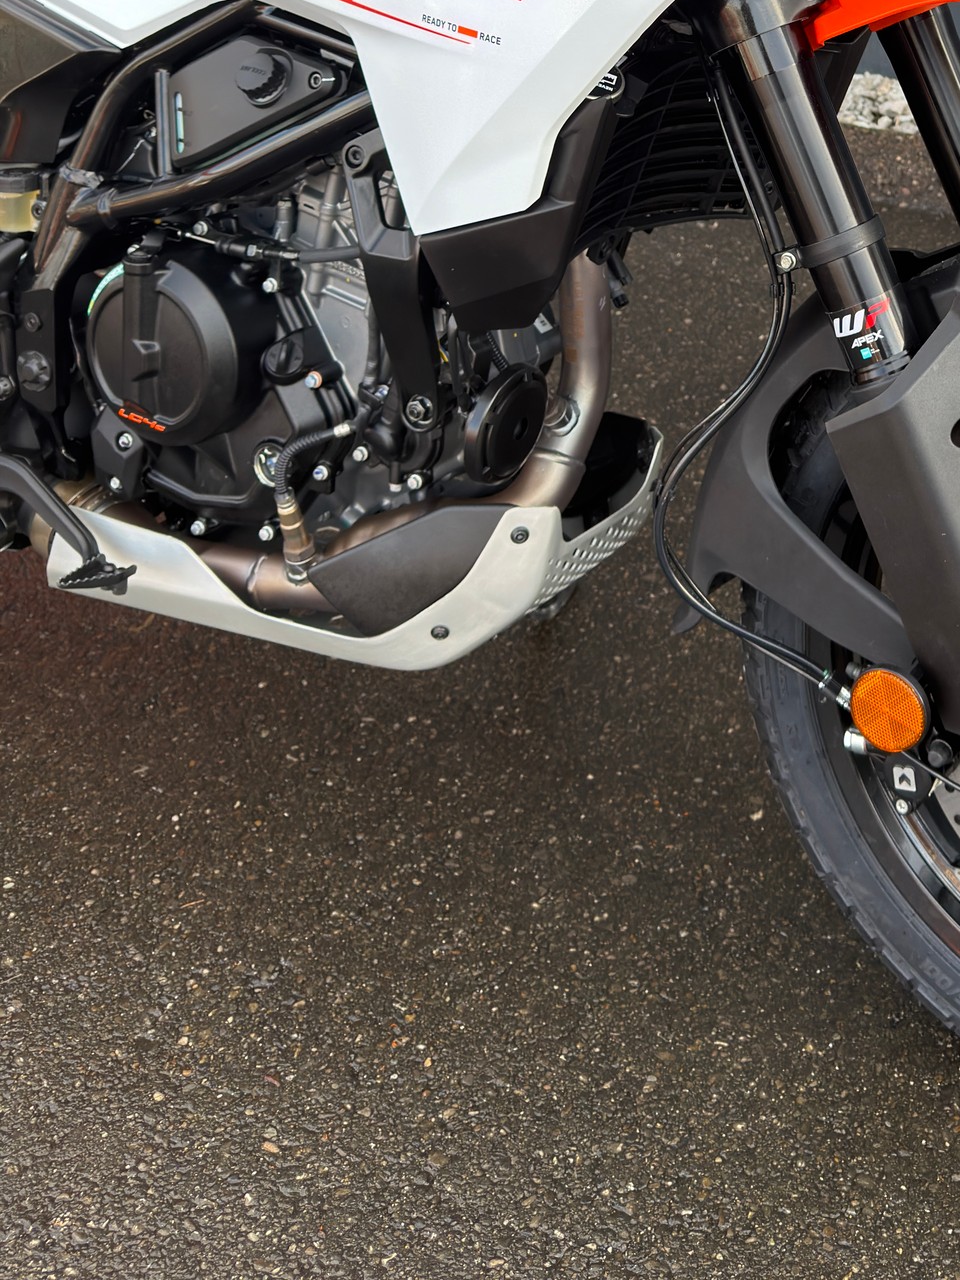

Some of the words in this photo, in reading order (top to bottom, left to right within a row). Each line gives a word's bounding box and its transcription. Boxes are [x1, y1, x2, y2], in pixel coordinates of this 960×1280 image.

[421, 14, 446, 29] READY
[447, 22, 457, 33] TO
[479, 32, 502, 46] RACE
[833, 298, 891, 338] WP
[851, 329, 884, 349] APEX
